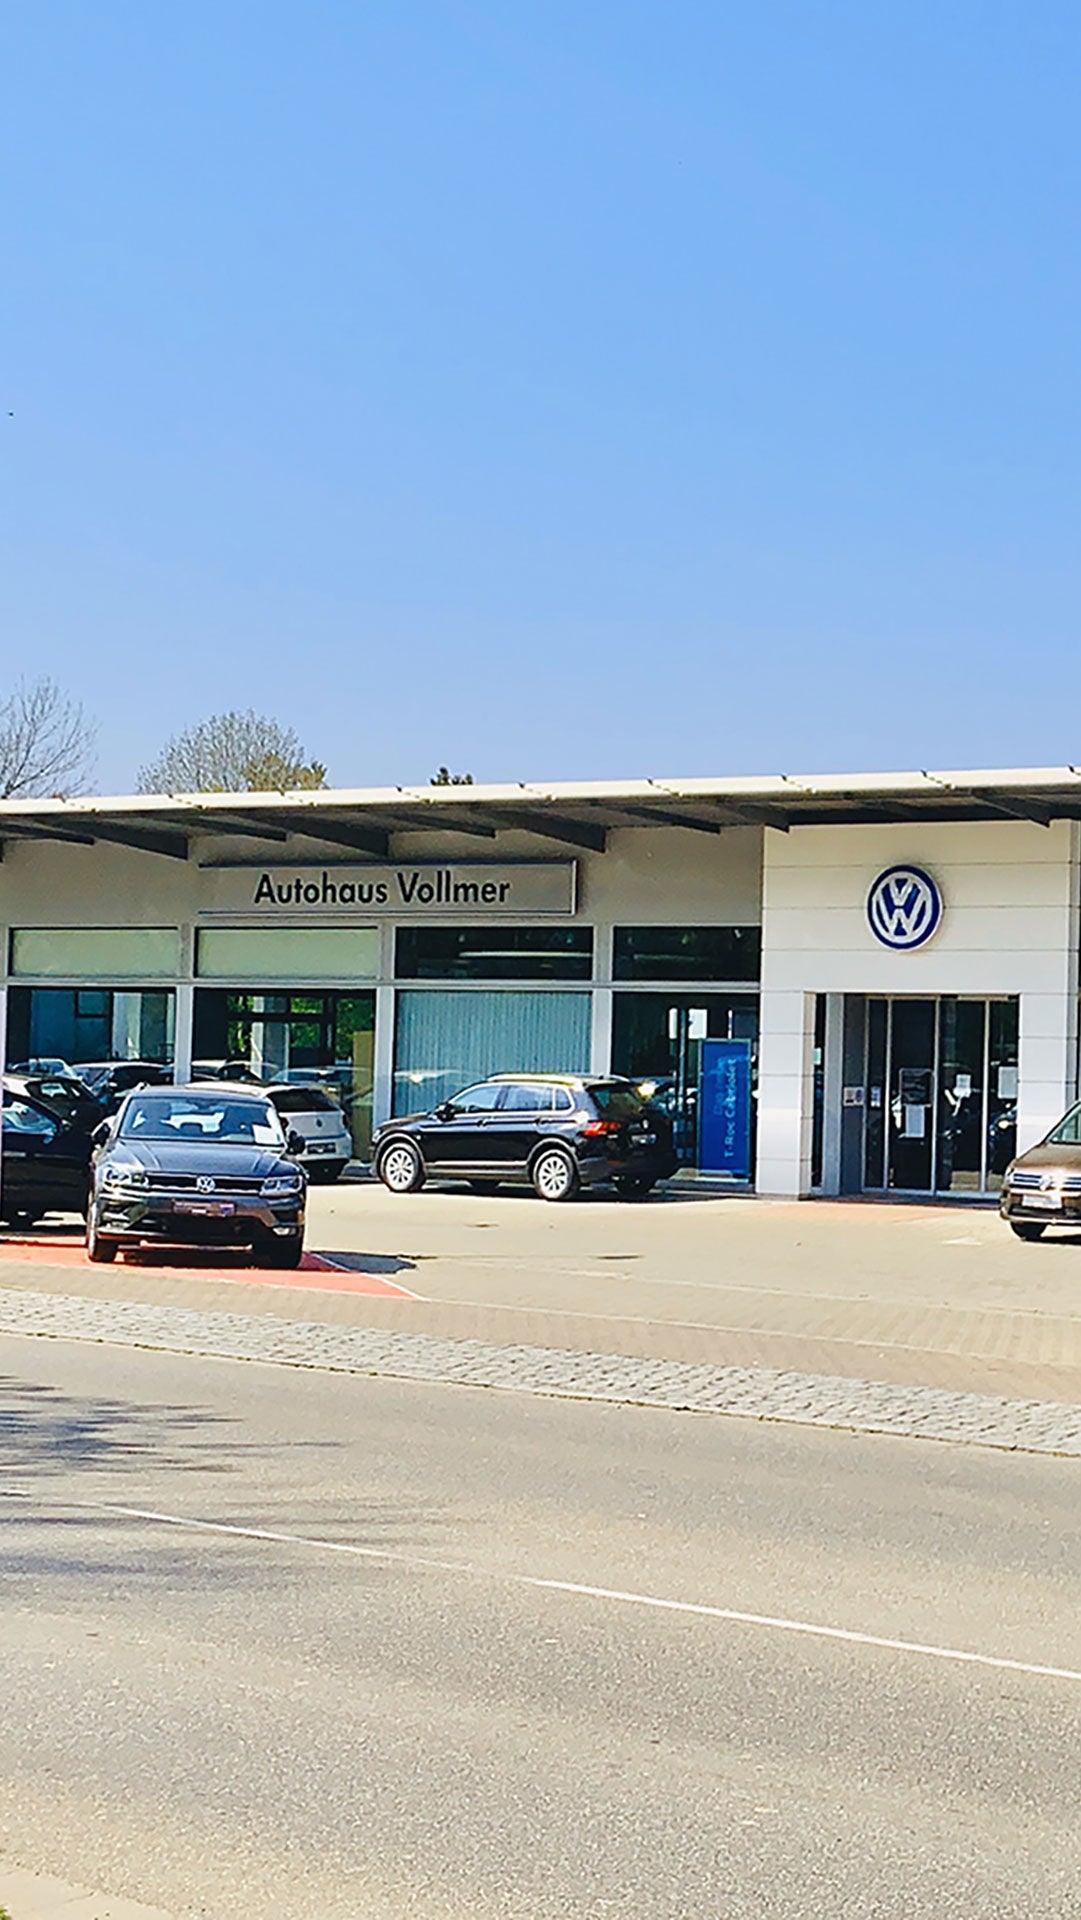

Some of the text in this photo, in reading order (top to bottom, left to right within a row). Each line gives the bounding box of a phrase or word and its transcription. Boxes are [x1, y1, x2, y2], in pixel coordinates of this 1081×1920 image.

[253, 869, 510, 905] Autohaus Vollmer
[870, 868, 936, 945] VW
[724, 1122, 735, 1157] T-Roc
